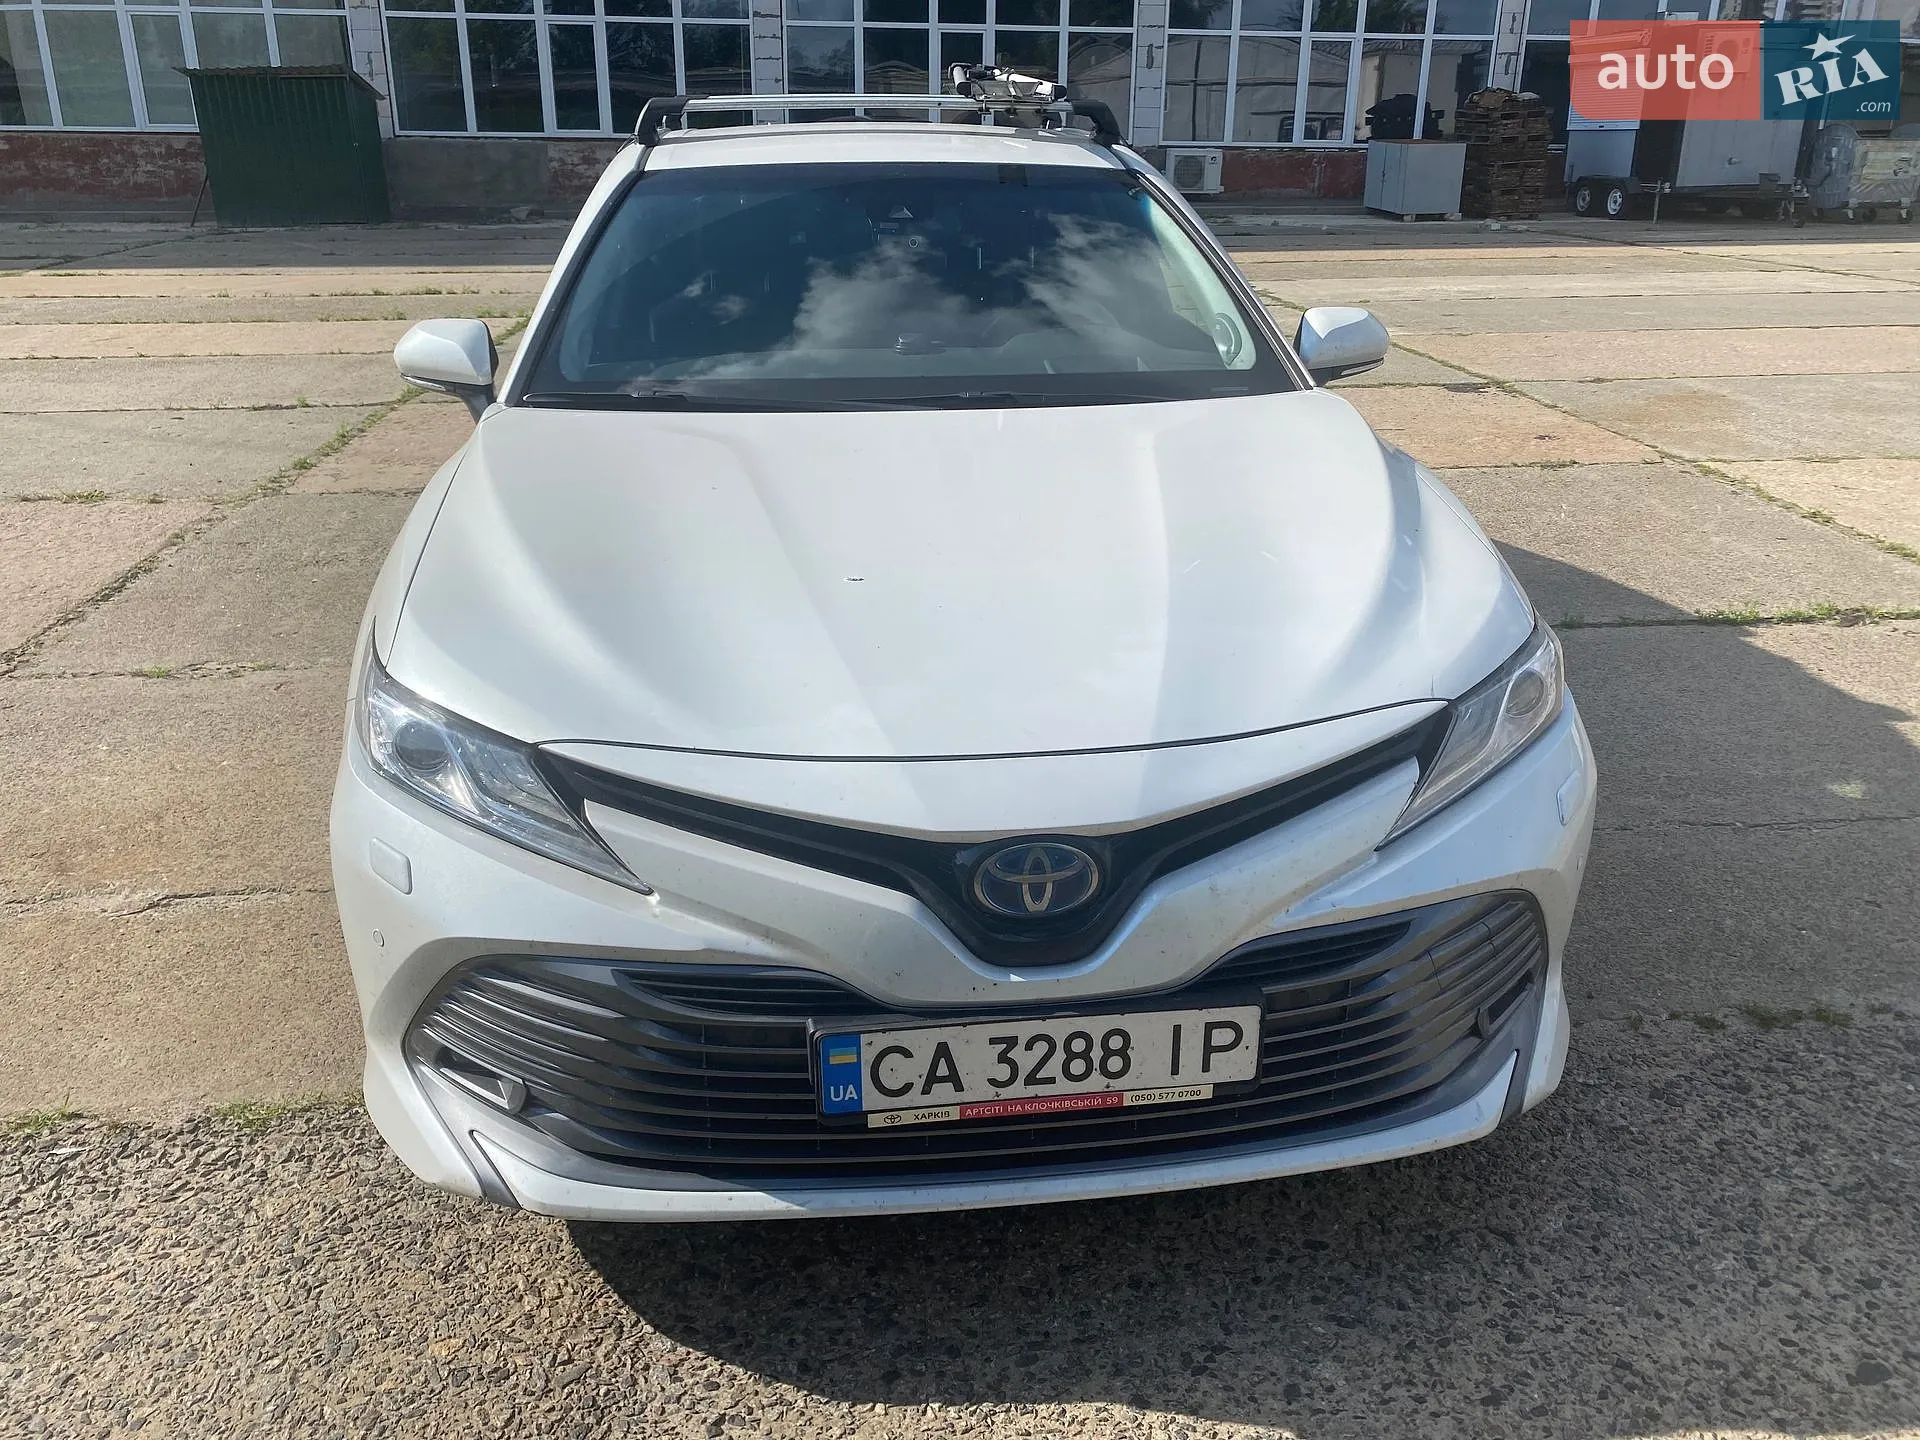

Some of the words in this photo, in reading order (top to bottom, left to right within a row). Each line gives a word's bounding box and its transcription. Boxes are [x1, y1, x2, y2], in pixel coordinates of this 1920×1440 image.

[869, 1042, 964, 1097] CA
[987, 1028, 1133, 1089] 3288
[1169, 1020, 1244, 1076] IP
[830, 1087, 858, 1102] UA
[913, 1110, 951, 1121] ХАРКІВ
[965, 1106, 1003, 1117] АРТСІТІ
[1008, 1103, 1023, 1112] НА
[1025, 1098, 1102, 1111] КЛОЧКІВСЬКІЙ
[1106, 1096, 1119, 1105] 59
[1130, 1092, 1156, 1102] (050)
[1158, 1091, 1176, 1100] 577
[1178, 1089, 1202, 1098] 0700
